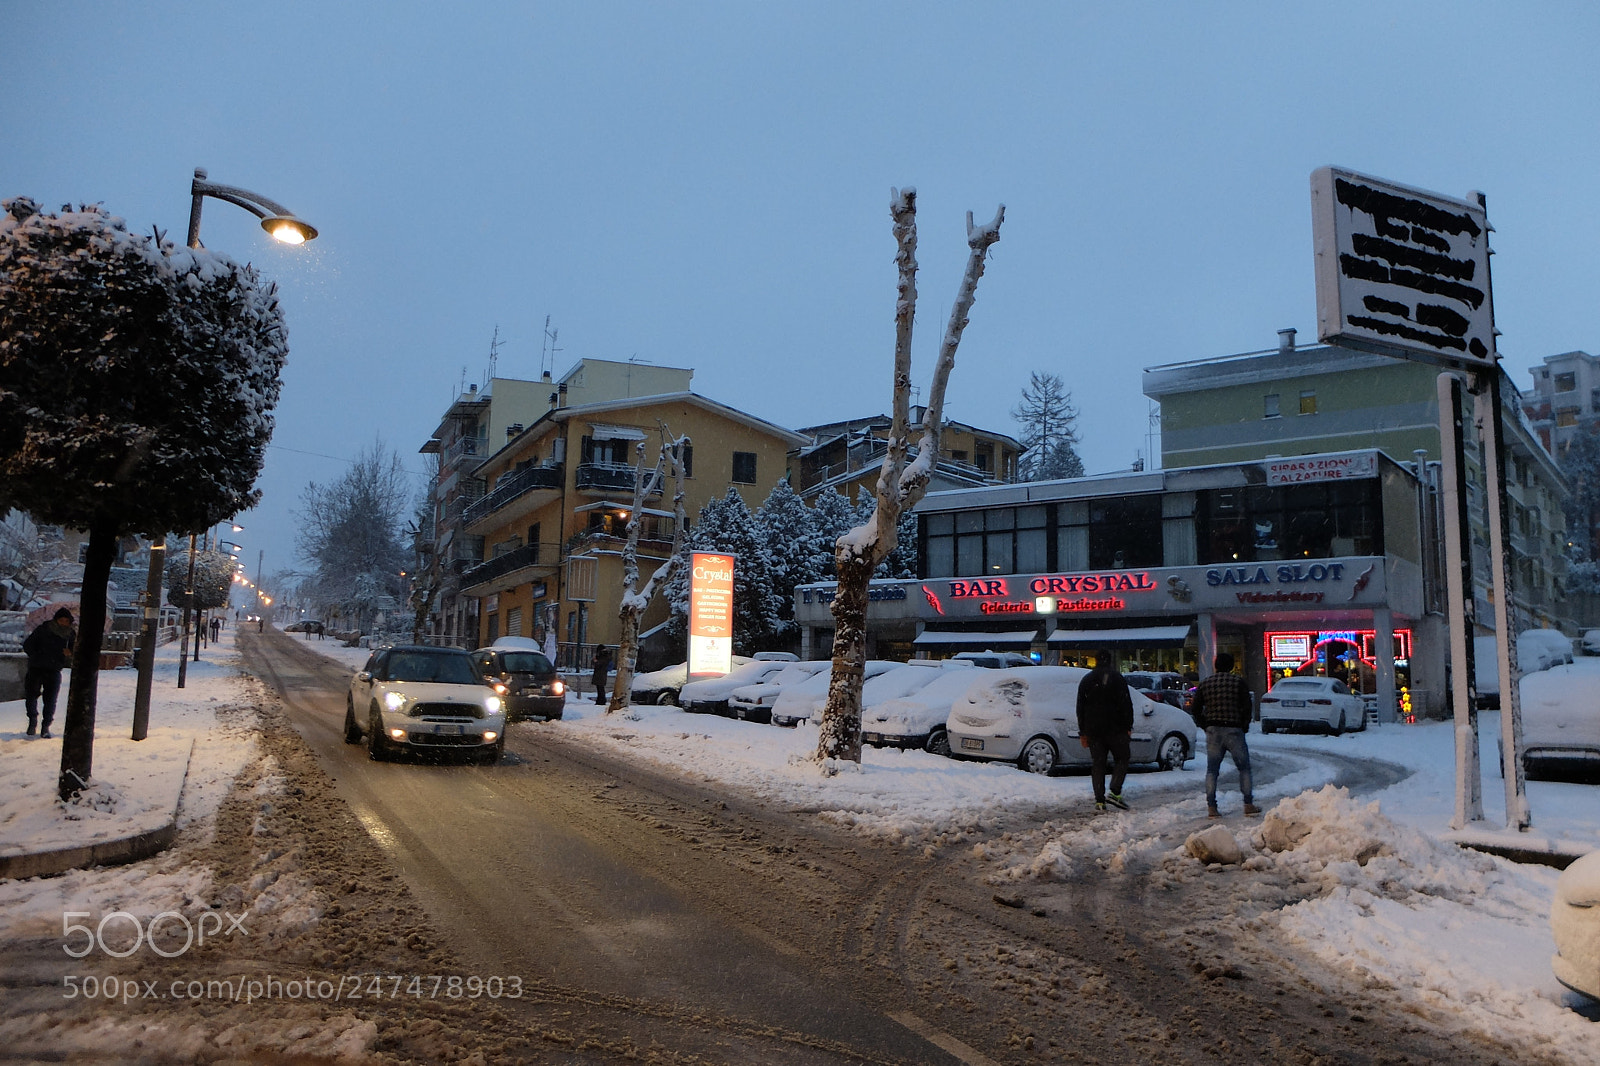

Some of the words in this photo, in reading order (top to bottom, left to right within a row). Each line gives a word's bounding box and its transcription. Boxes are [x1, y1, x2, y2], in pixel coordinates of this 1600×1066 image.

[692, 567, 732, 583] Crystal
[1206, 567, 1270, 586] SALA
[1277, 562, 1344, 582] SLOT
[949, 576, 1005, 597] BAR
[1029, 573, 1154, 594] CRYSTAL
[979, 601, 1031, 614] Gelateria
[1056, 598, 1121, 611] Pasticceria
[1316, 630, 1356, 643] JACKPOT
